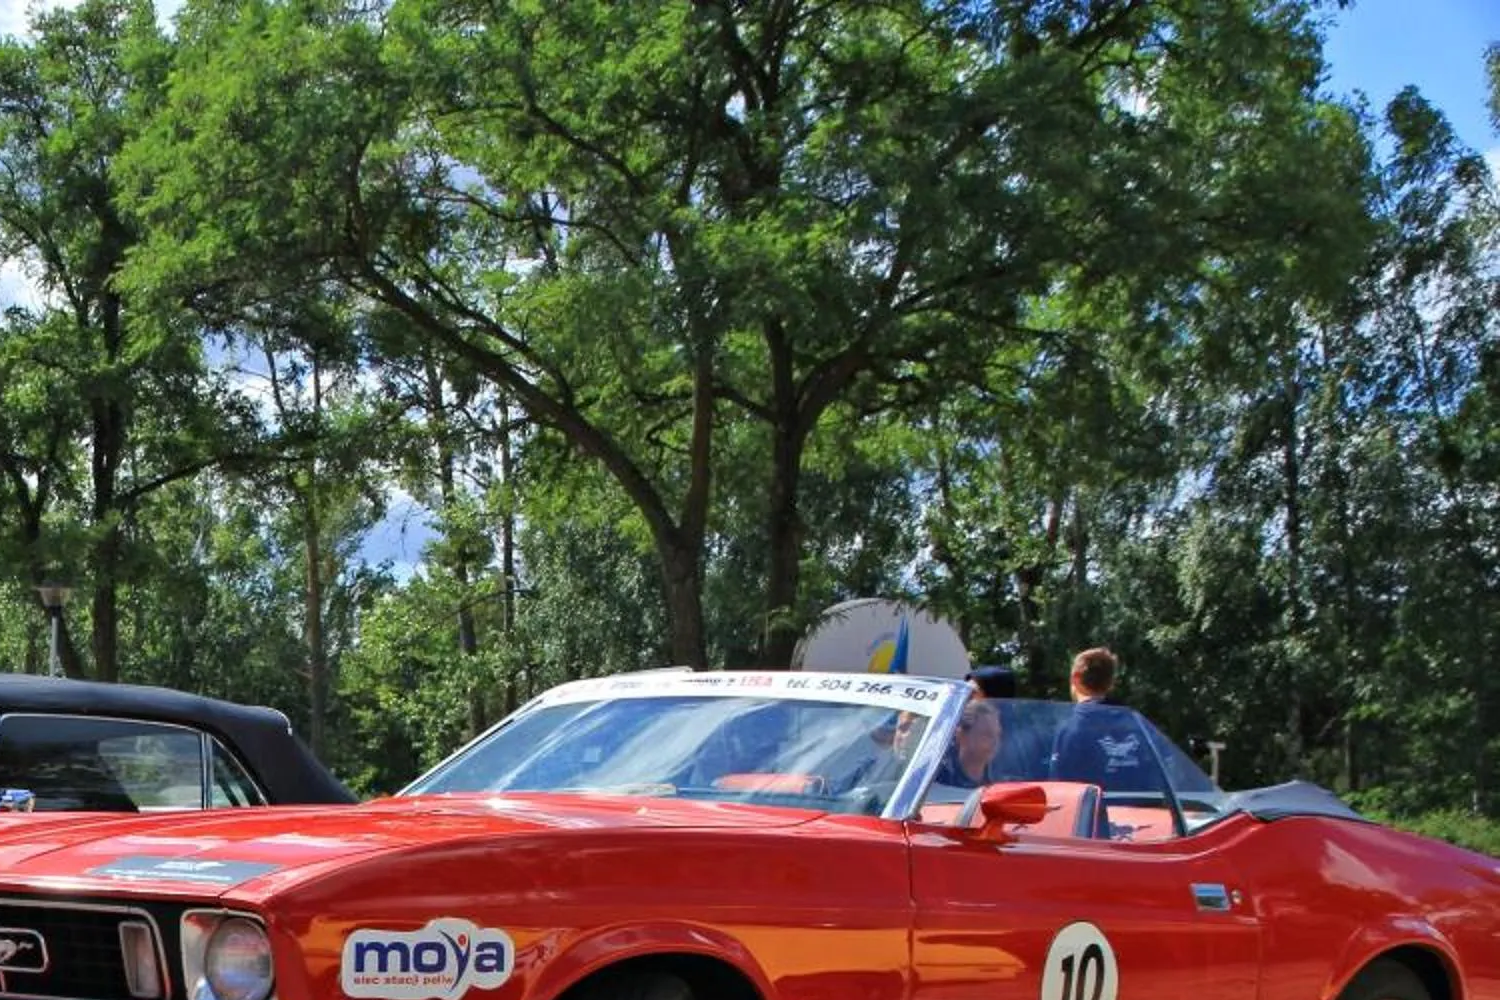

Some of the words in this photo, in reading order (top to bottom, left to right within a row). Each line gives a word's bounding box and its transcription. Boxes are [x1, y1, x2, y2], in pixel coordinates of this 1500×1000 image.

[816, 677, 851, 691] 504
[856, 681, 892, 695] 266
[900, 686, 940, 701] 504
[354, 930, 505, 992] moya
